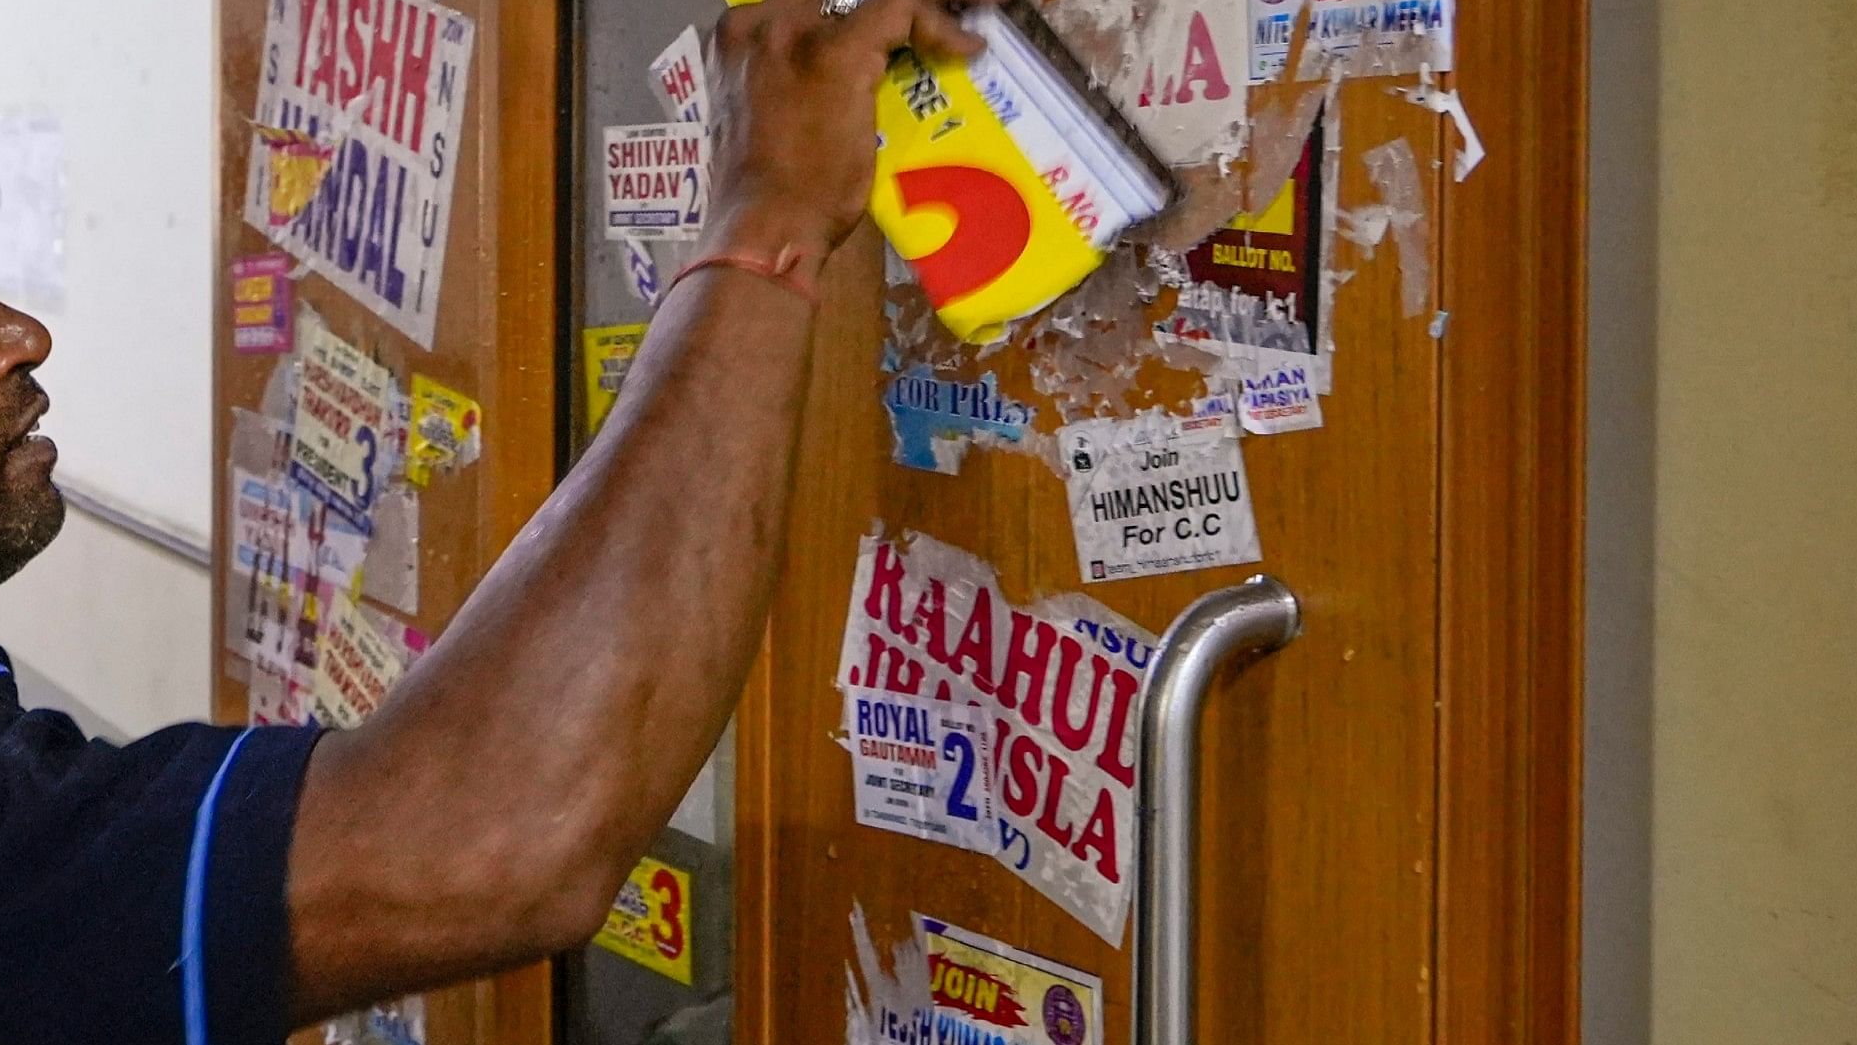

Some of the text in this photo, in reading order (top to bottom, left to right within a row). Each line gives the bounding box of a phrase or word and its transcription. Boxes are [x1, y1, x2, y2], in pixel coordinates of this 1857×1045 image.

[607, 137, 700, 169] SHIIVAM
[609, 166, 701, 225] YADAV 2
[1212, 243, 1296, 272] BALLOT NO.
[896, 376, 940, 413] FOR
[355, 426, 377, 511] 3
[1139, 448, 1180, 472] Join
[1091, 470, 1241, 523] HIMANSHUU
[1121, 513, 1222, 549] For C.C
[863, 543, 1140, 789] RAAHUL
[1073, 618, 1155, 670] NSU
[857, 698, 936, 747] ROYAL
[860, 738, 938, 770] GAUTAMM
[943, 731, 979, 822] 2
[650, 868, 685, 961] 3
[929, 962, 1000, 1013] JOIN
